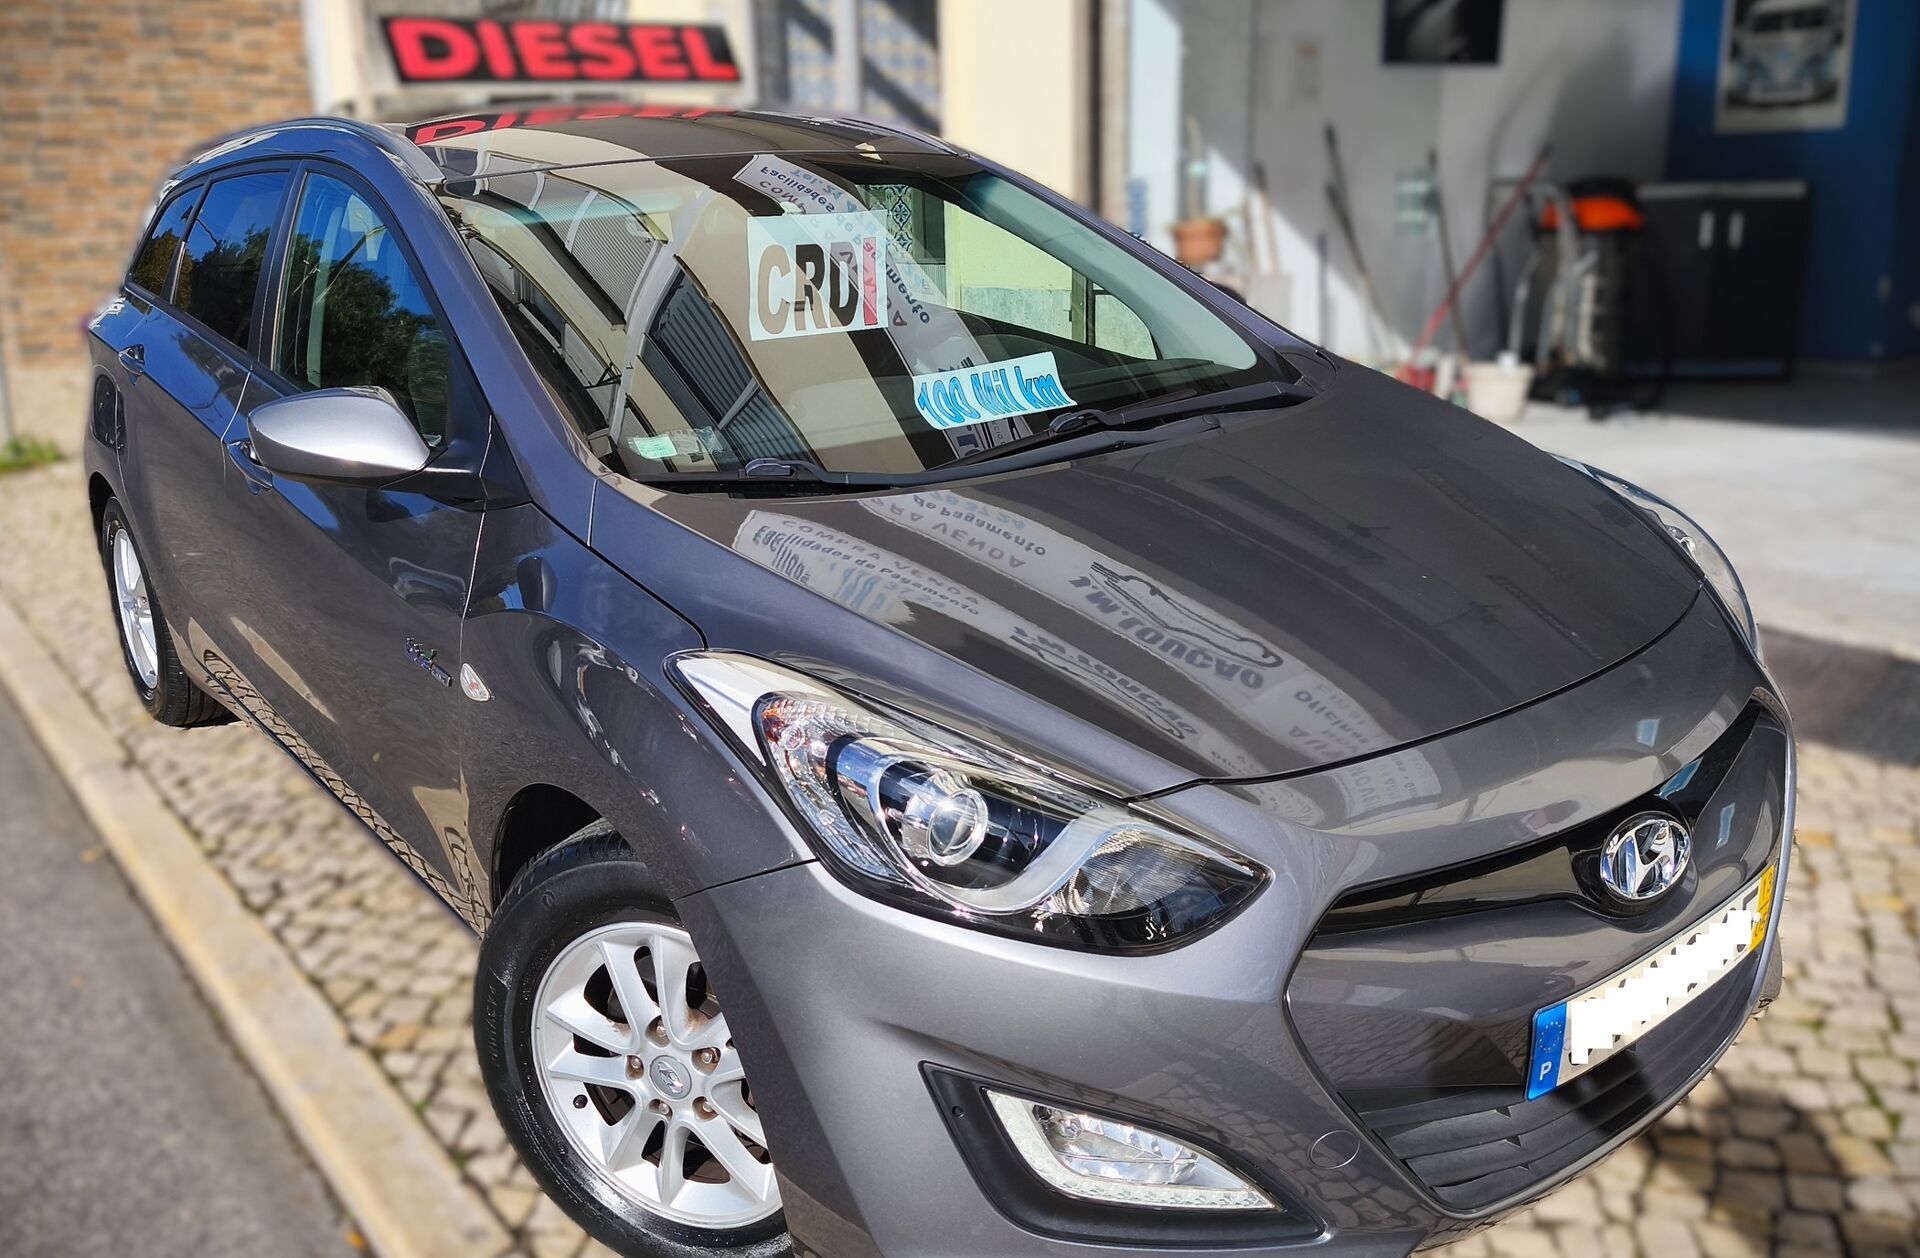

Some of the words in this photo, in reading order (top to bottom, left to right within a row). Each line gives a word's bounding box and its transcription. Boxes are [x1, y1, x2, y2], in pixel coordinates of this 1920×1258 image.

[388, 18, 740, 80] DIESEL
[757, 236, 879, 335] CRDI
[918, 376, 982, 427] 100
[970, 368, 1028, 416] Mil
[1014, 365, 1072, 410] km
[781, 519, 881, 561] COMPRA
[893, 560, 980, 605] VENDA
[854, 557, 877, 570] de
[878, 567, 981, 617] Pagamento
[1539, 1060, 1553, 1081] P
